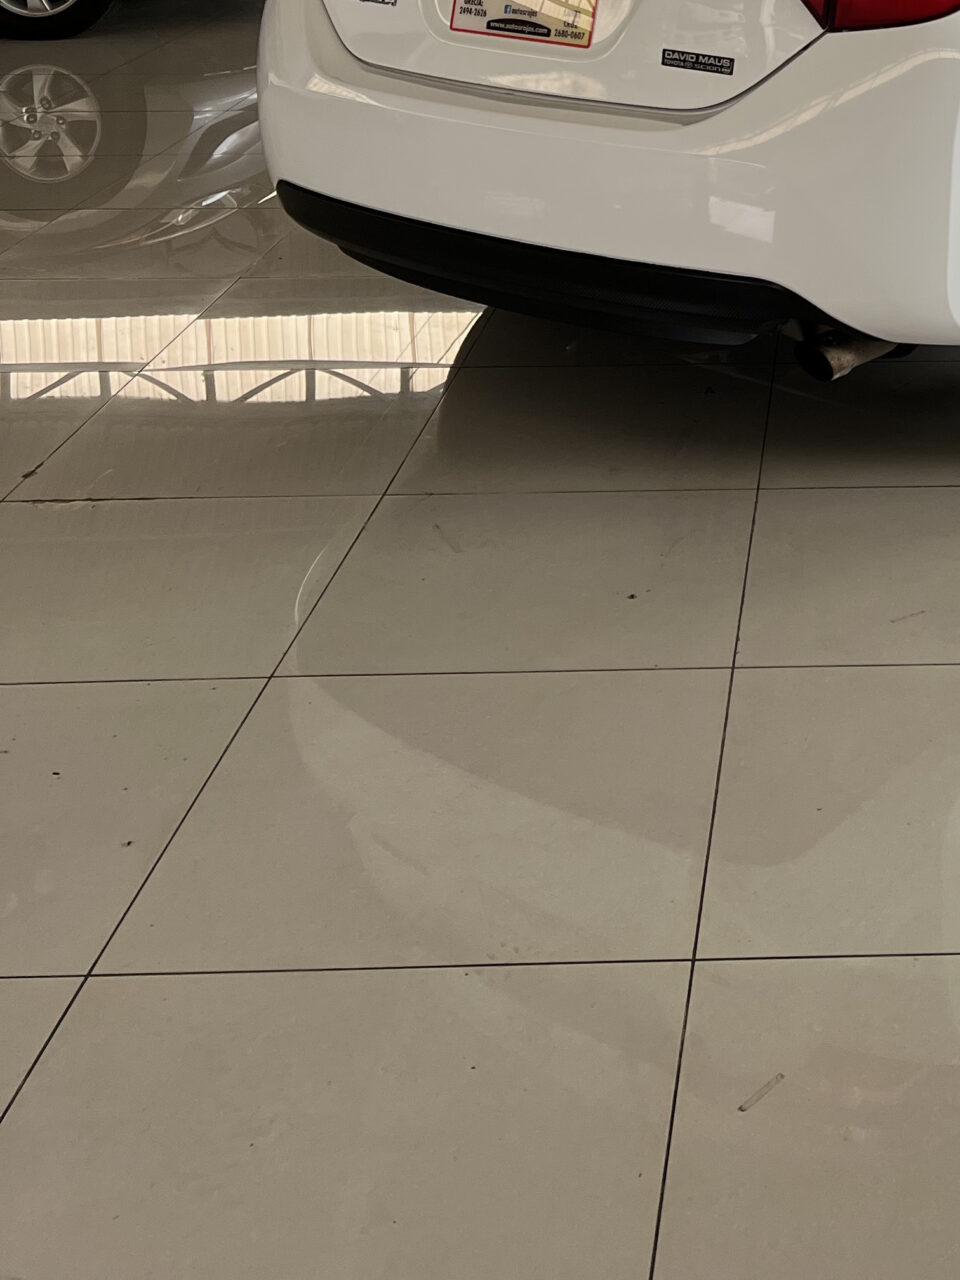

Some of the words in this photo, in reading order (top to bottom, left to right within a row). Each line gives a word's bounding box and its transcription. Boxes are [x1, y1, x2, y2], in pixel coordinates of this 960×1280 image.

[511, 7, 538, 19] autosrojas
[490, 21, 549, 35] www.autosrojas.com
[554, 28, 585, 41] 2680-0607
[664, 50, 697, 63] DAVID
[698, 55, 731, 68] MAUS
[664, 58, 685, 67] TOYOTA
